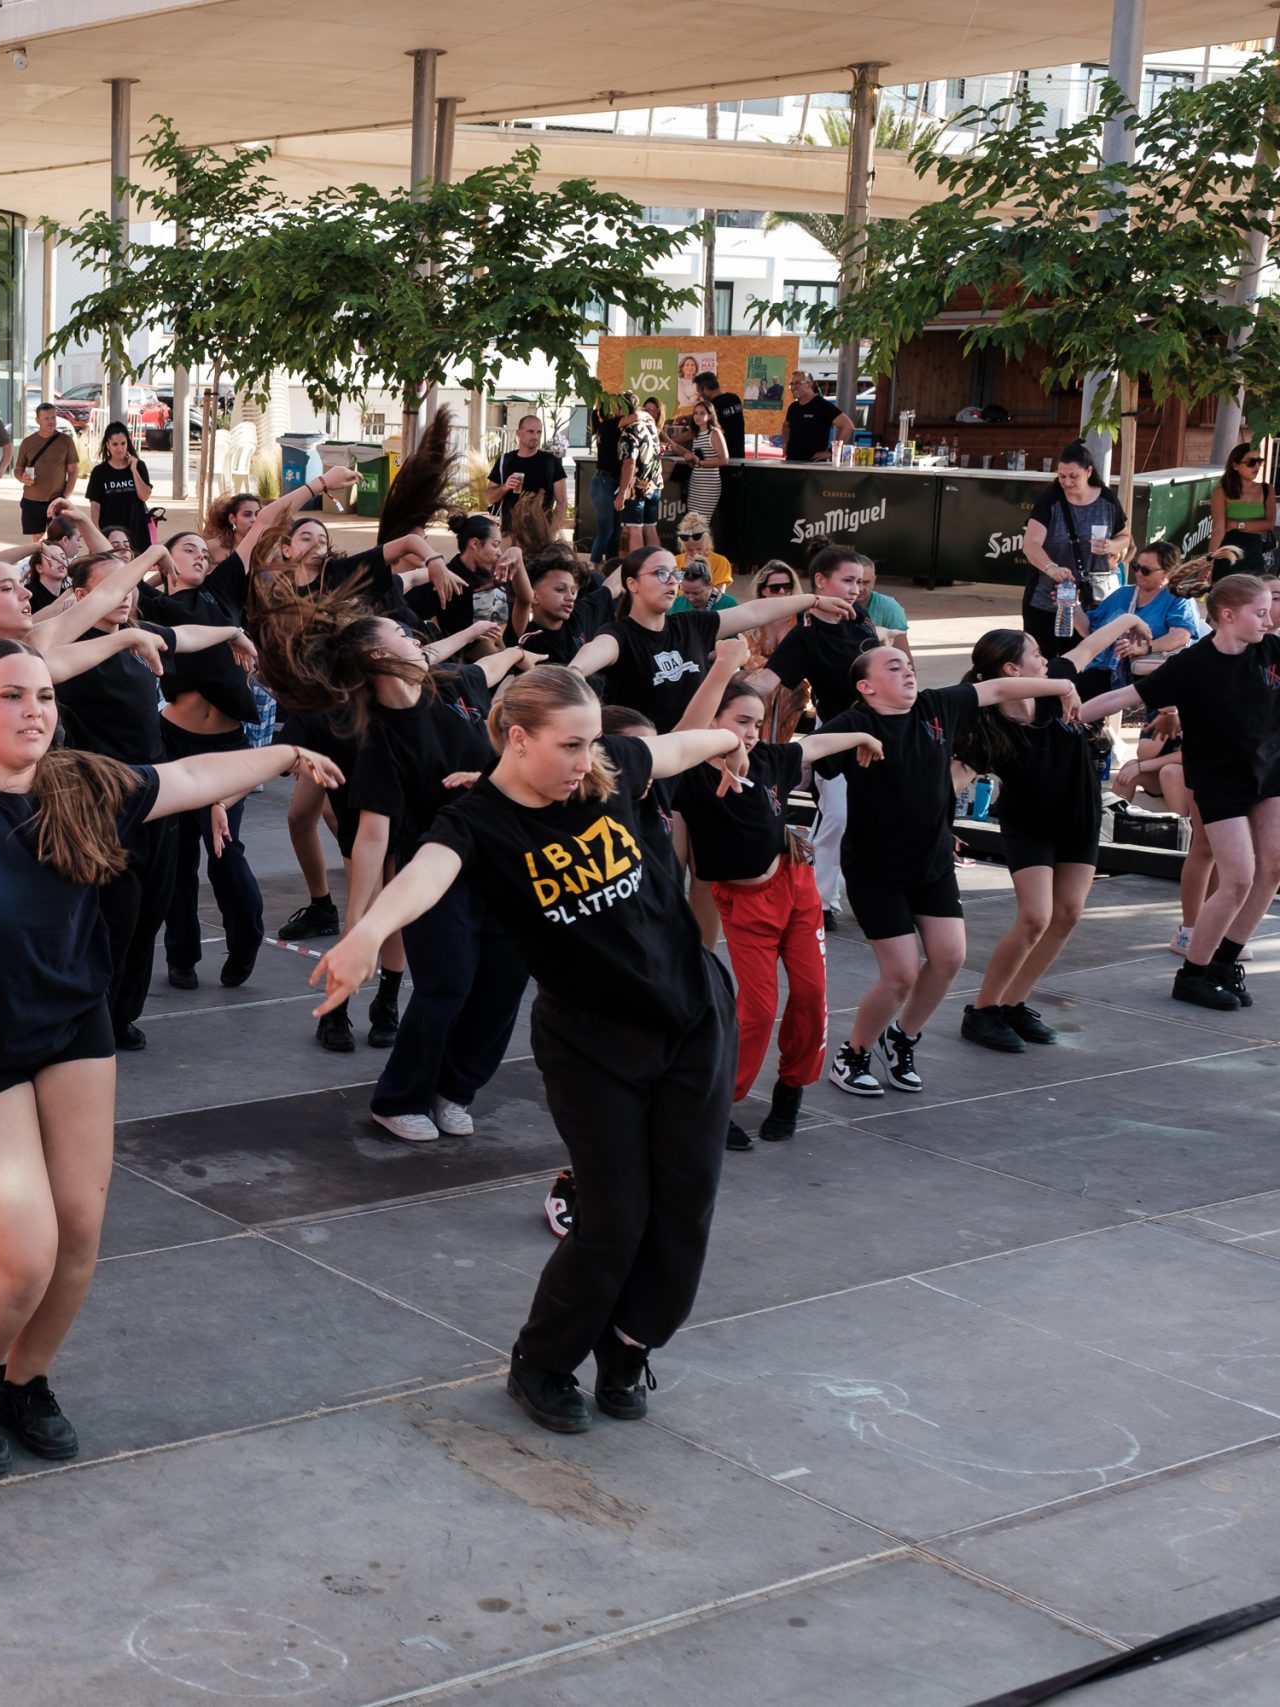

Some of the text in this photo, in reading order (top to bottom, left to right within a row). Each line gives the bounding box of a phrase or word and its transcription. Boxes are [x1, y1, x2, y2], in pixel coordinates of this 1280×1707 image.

[640, 358, 663, 371] VOTA
[630, 372, 671, 393] VOX
[110, 480, 134, 489] DANC
